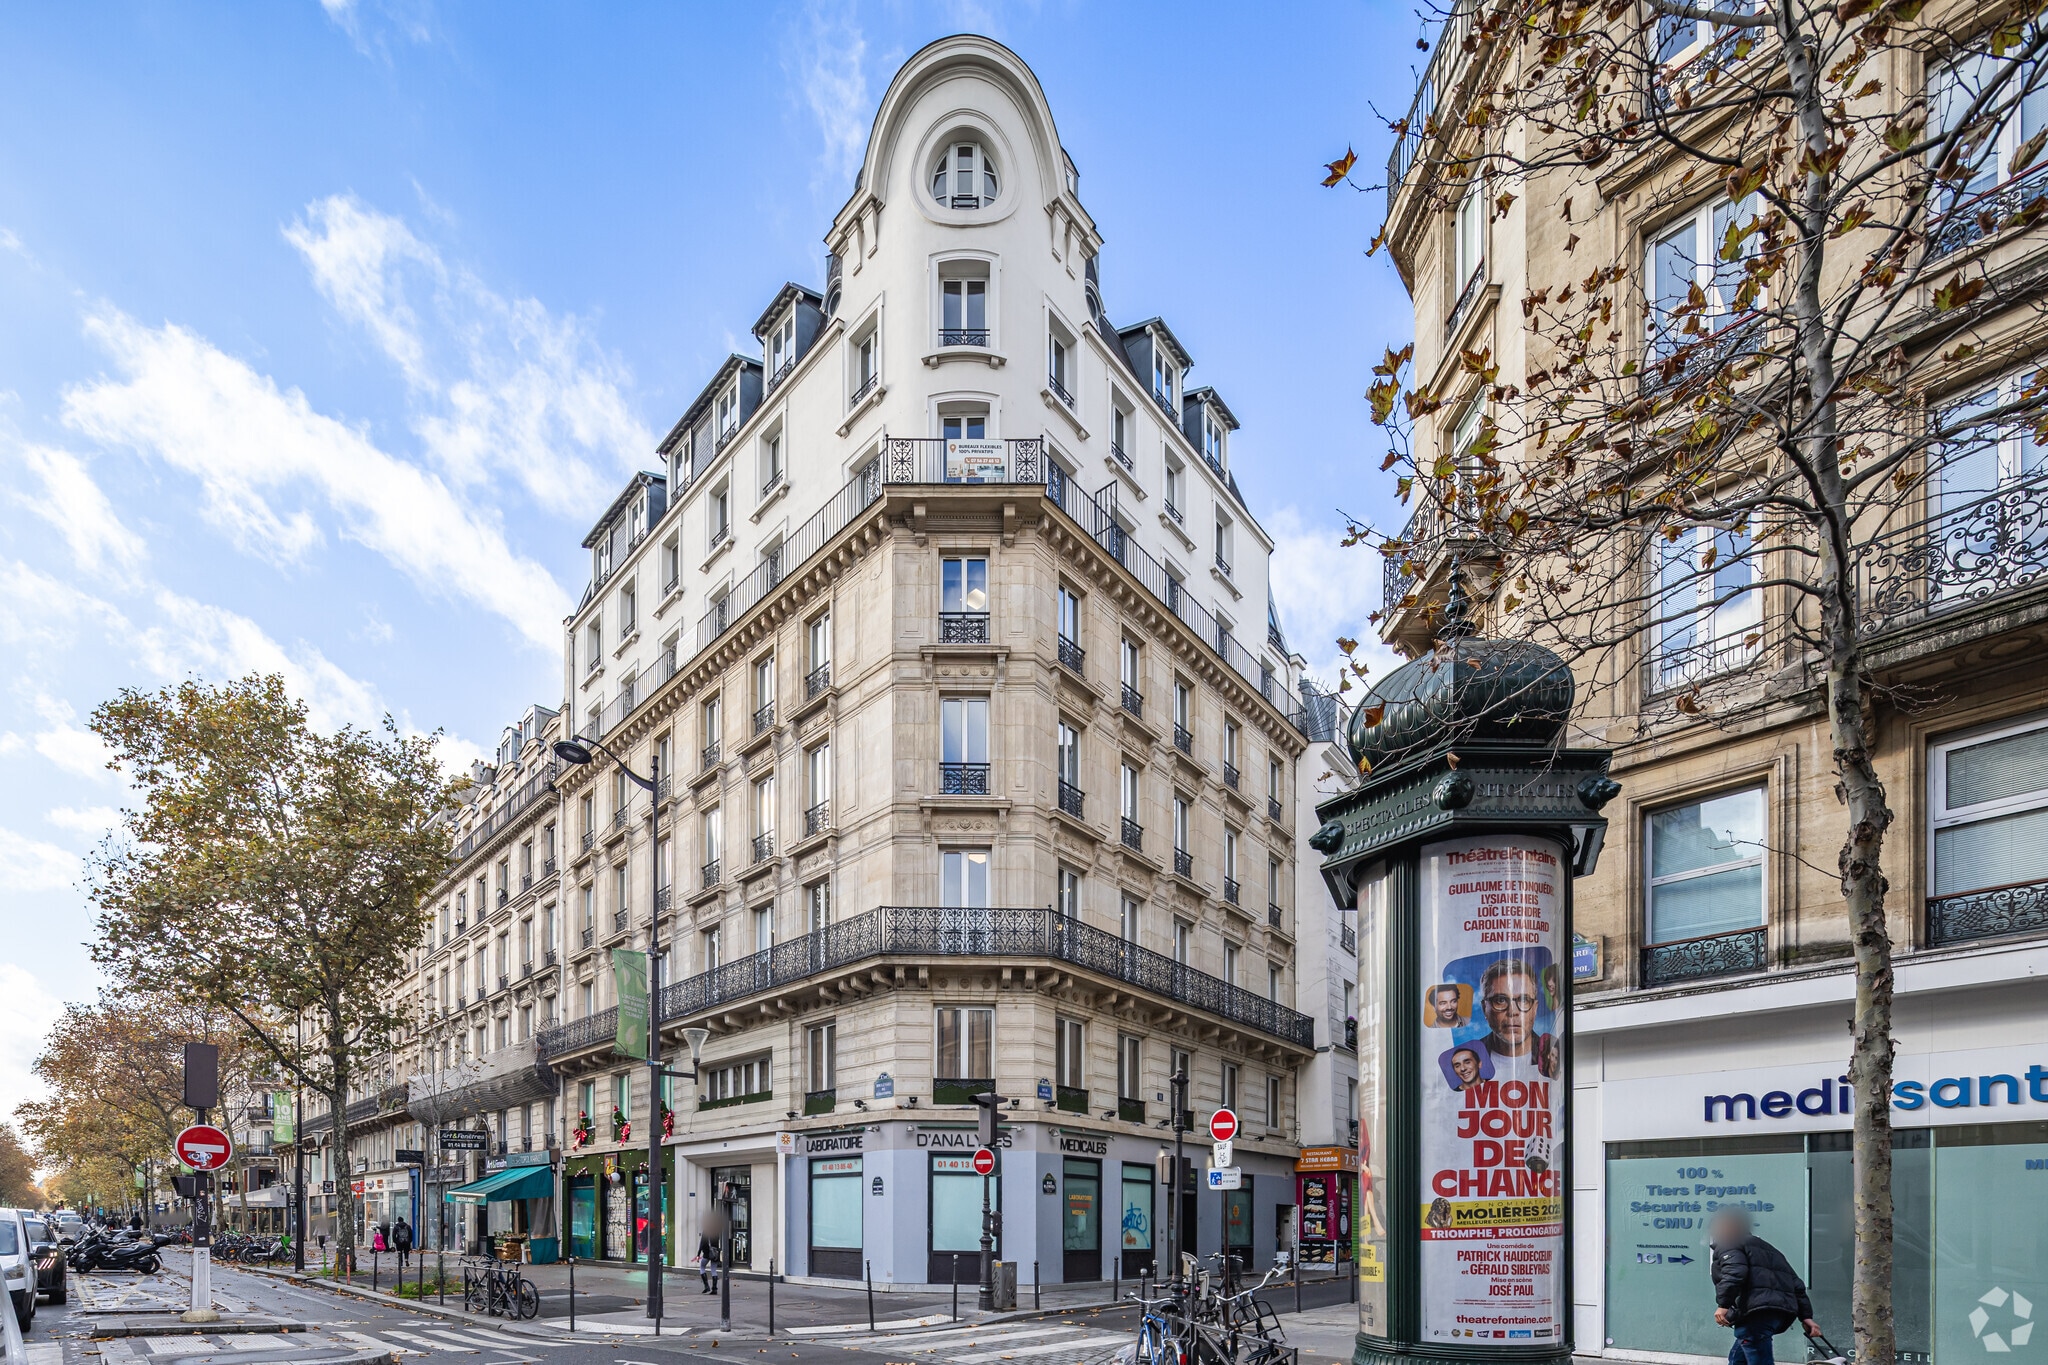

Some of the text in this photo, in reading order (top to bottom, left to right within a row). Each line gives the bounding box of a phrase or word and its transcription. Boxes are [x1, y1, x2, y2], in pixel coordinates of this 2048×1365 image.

[1476, 783, 1575, 798] SPECTACLES
[1345, 792, 1431, 838] SPECTACLES
[1448, 880, 1503, 896] GUILLAUME
[1504, 880, 1517, 891] DE
[1481, 893, 1518, 905] LYSIANE
[1477, 904, 1542, 918] LOÏC LEGENDRE
[1463, 918, 1550, 932] CAROLINE MAILLARD
[1480, 931, 1540, 943] JEAN FRANCO
[1464, 1080, 1549, 1109] MON
[275, 1104, 291, 1116] 10
[1457, 1110, 1552, 1139] JOUR
[806, 1135, 863, 1152] LABORATOIRE
[1060, 1137, 1107, 1155] MEDICALES
[1473, 1140, 1525, 1168] DE
[1676, 1166, 1724, 1179] 100 %
[1432, 1169, 1560, 1198] CHANCE
[1646, 1183, 1757, 1197] Tiers Payant
[1456, 1205, 1540, 1220] MOLIÈRES
[1630, 1200, 1702, 1213] Sécurité
[1653, 1217, 1693, 1229] CMU
[1430, 1228, 1496, 1239] TRIOMPHE,
[1457, 1250, 1552, 1262] PATRICK HAUDECŒUR
[1636, 1252, 1663, 1264] ICI
[1470, 1262, 1509, 1275] GÉRALD
[1511, 1263, 1550, 1275] SIBLEYRAS
[1489, 1283, 1534, 1296] JOSÉ PAUL
[1456, 1315, 1552, 1325] theatrefontaine.com
